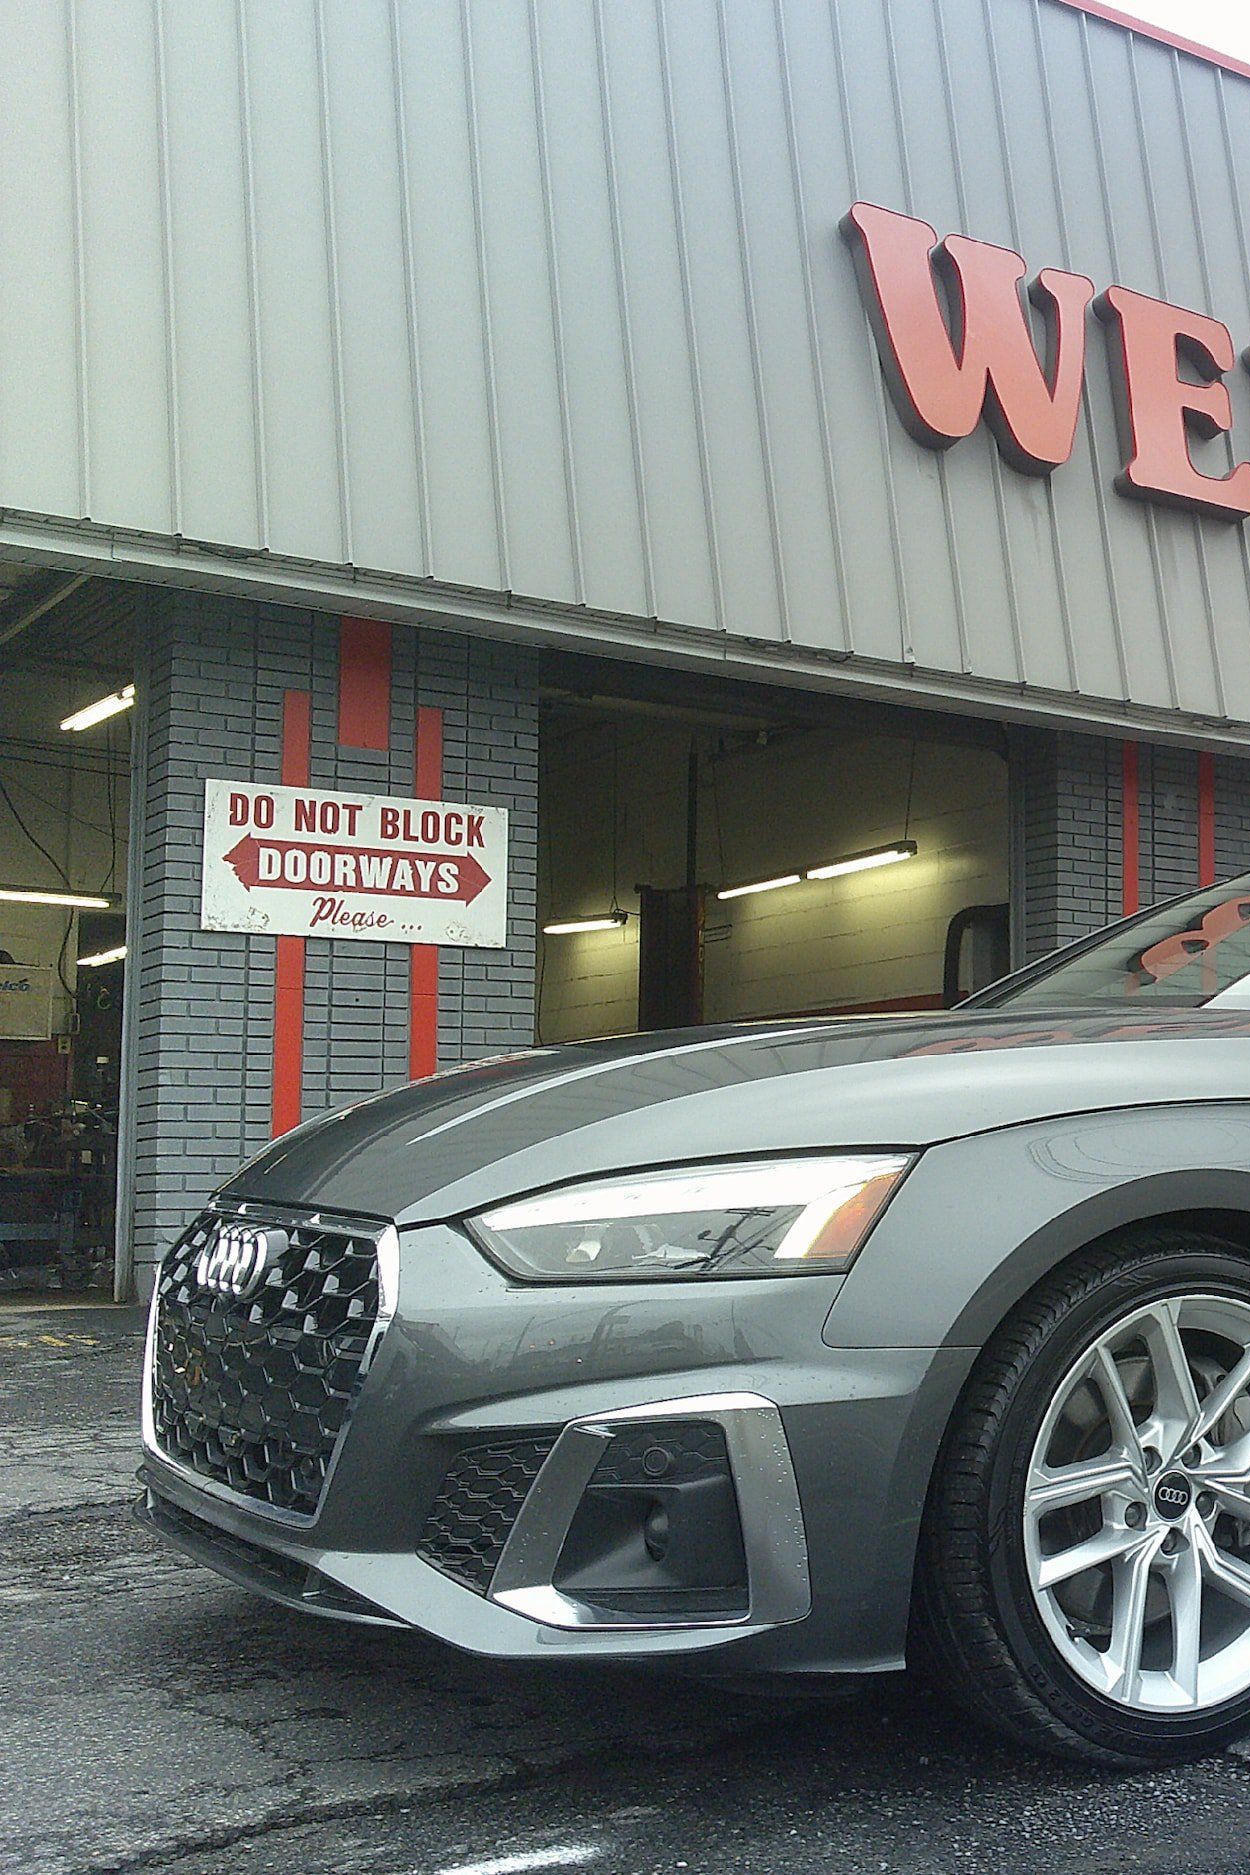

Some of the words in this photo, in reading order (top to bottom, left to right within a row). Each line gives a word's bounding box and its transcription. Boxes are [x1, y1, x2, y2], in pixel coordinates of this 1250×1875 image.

[229, 793, 275, 829] DO
[294, 798, 363, 837] NOT
[380, 807, 485, 848] BLOCK
[258, 847, 460, 894] DOORWAYS
